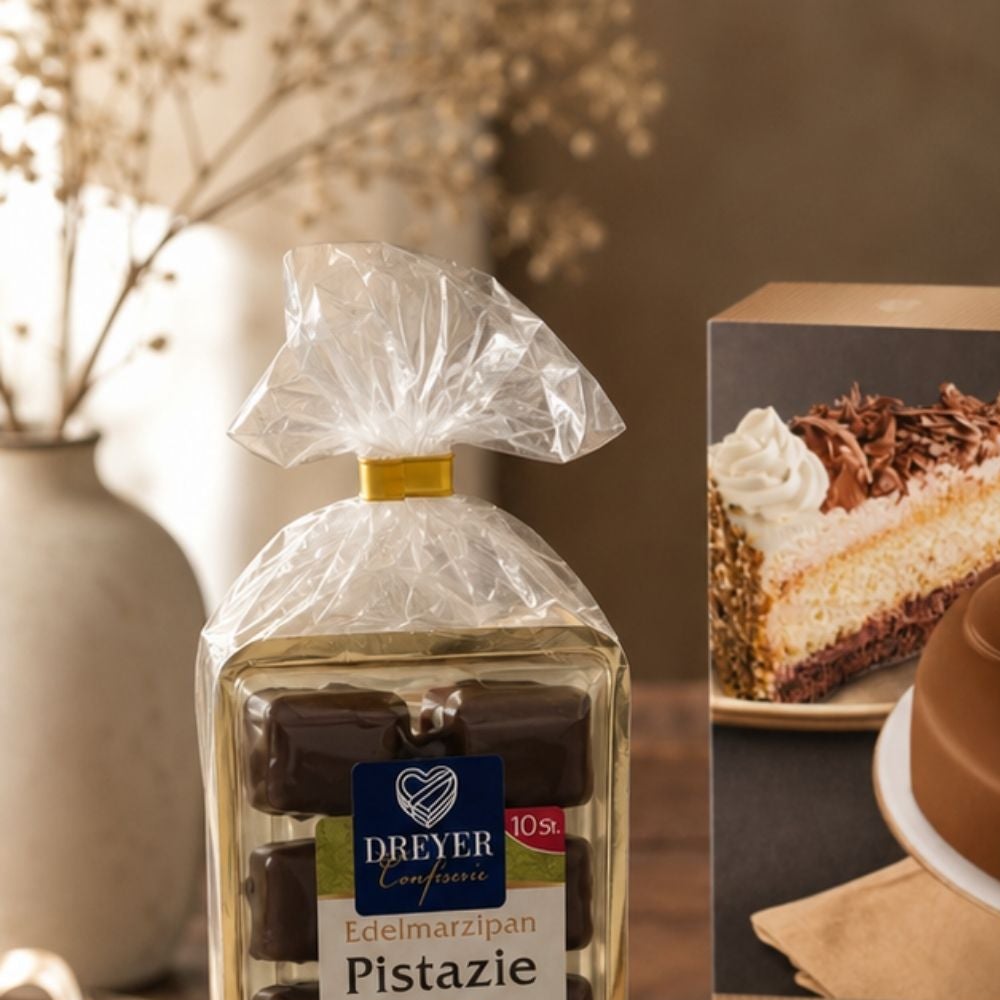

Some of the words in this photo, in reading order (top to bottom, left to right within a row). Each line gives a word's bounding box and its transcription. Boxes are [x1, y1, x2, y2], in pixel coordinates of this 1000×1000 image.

[511, 814, 537, 837] 10
[363, 831, 494, 864] DREYER
[345, 914, 537, 944] Edelmarzipan
[346, 948, 537, 995] Pistazie
